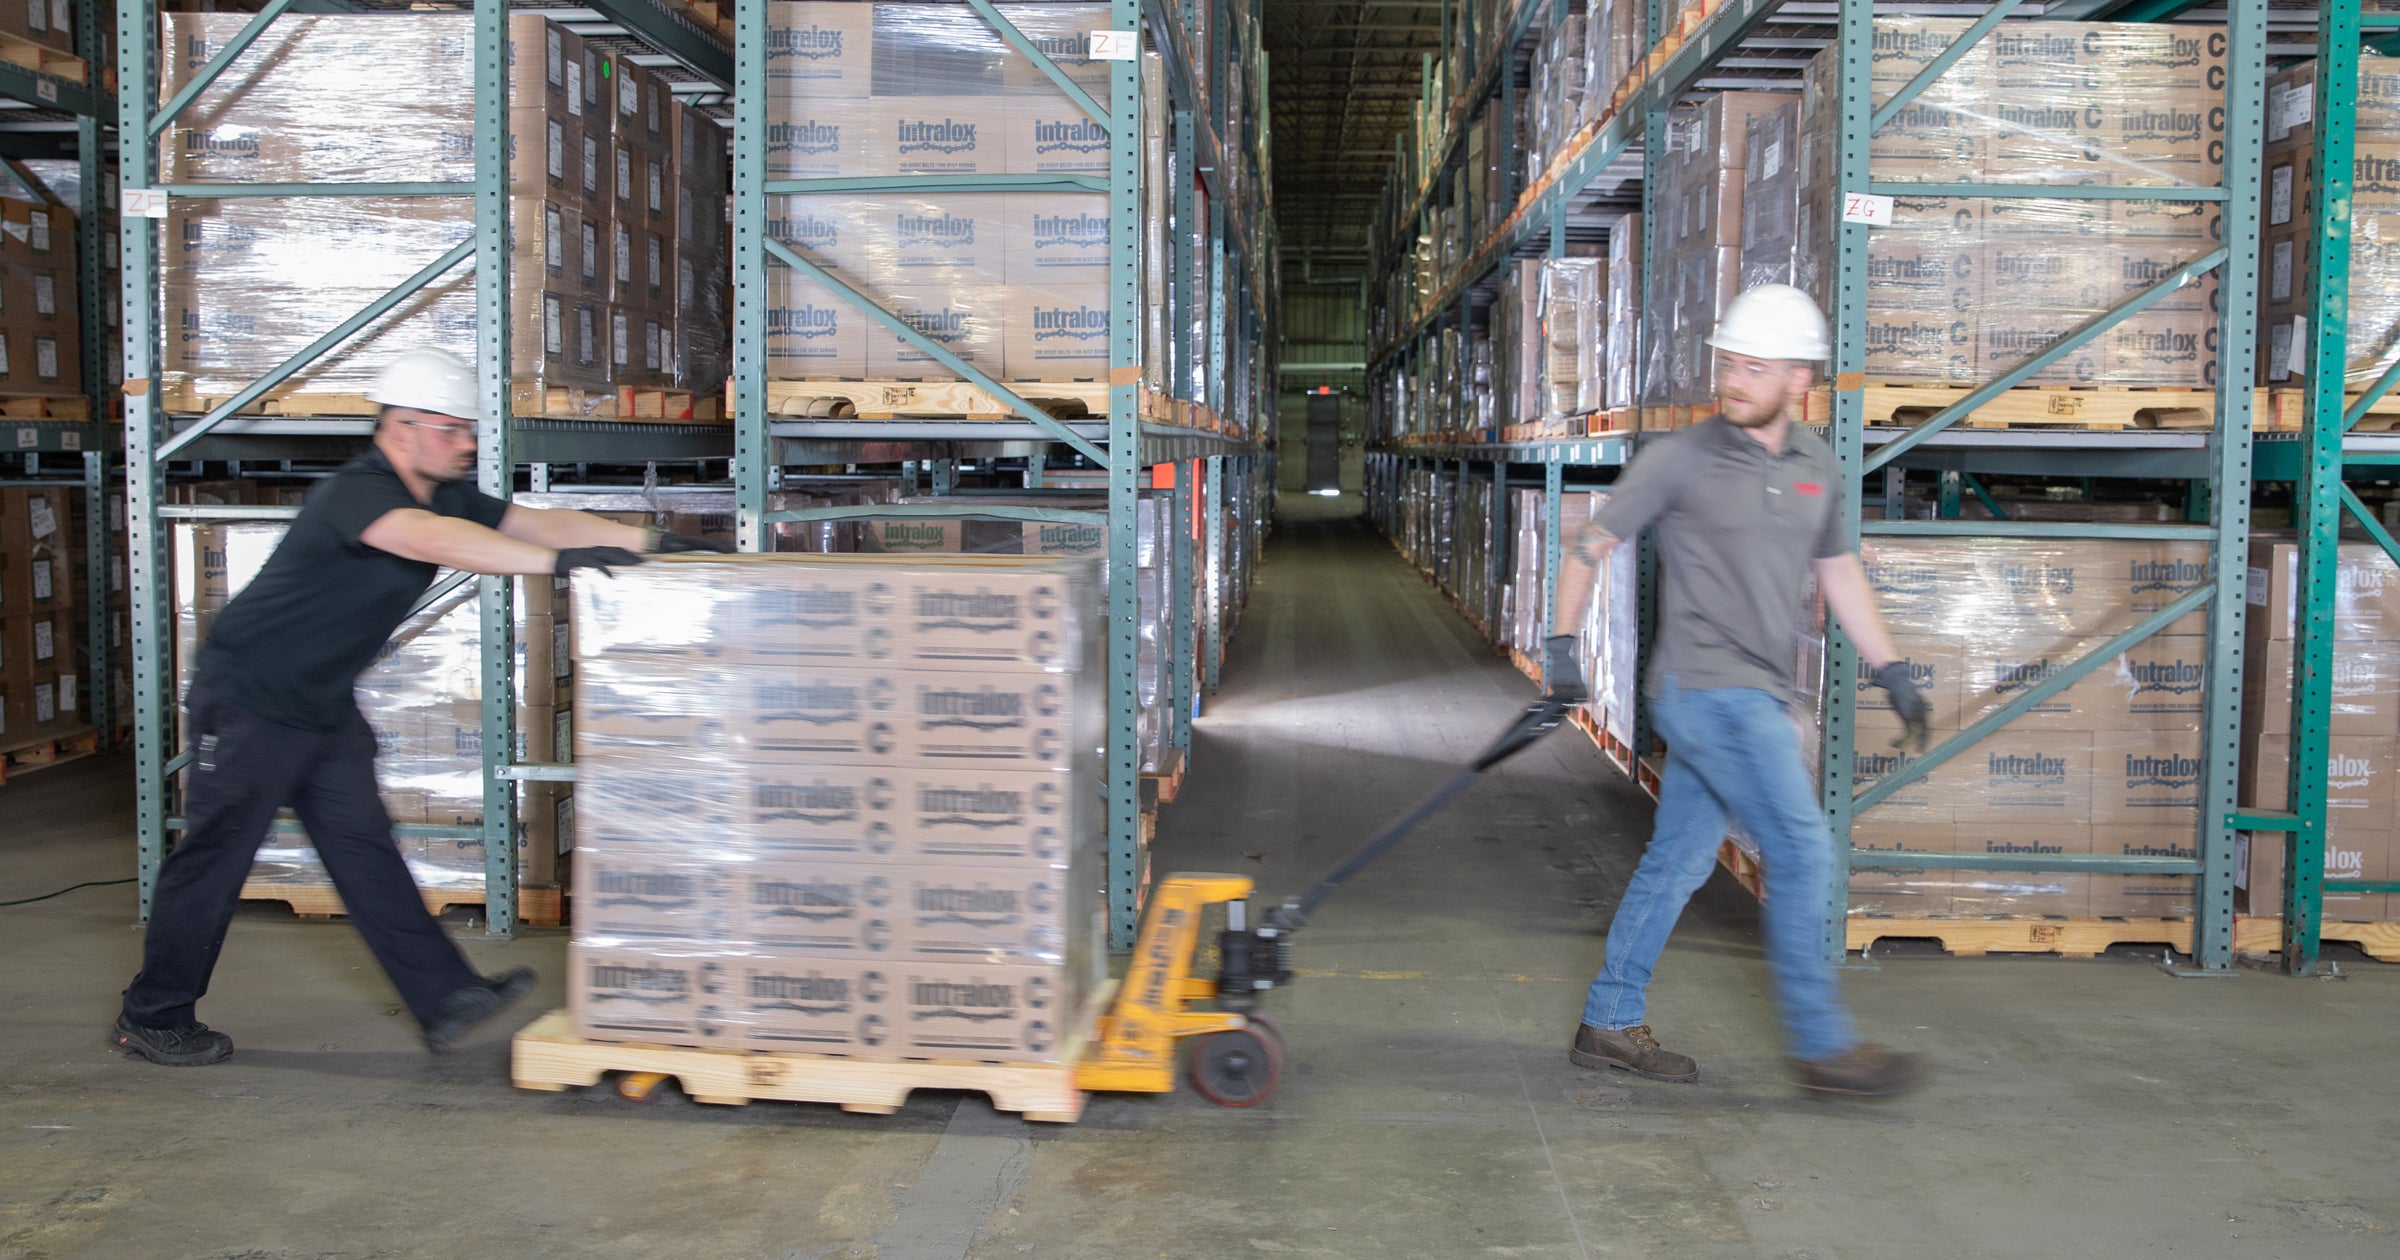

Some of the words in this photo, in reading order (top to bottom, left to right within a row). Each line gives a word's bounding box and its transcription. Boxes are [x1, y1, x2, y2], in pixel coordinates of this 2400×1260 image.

[1996, 32, 2076, 56] intralox
[2083, 31, 2101, 56] C
[2207, 33, 2226, 57] C
[2206, 65, 2225, 91] C
[1888, 104, 1949, 127] tralox
[1998, 104, 2077, 129] intralox
[2084, 103, 2102, 129] C
[2121, 108, 2202, 131] intralox
[2208, 107, 2224, 132] C
[769, 120, 840, 143] ntralox
[899, 119, 977, 142] intralox
[1035, 118, 1111, 142] intralox
[2207, 140, 2223, 165] C
[1846, 198, 1875, 217] ZG
[768, 215, 838, 238] ntralox
[898, 213, 974, 236] intralox
[1034, 213, 1111, 236] intralox
[1954, 209, 1972, 232] C
[1953, 254, 1972, 279] C
[1952, 287, 1971, 312] C
[768, 304, 837, 327] ntralox
[1034, 305, 1111, 329] intralox
[1949, 321, 1968, 345] C
[2117, 328, 2198, 351] intralox
[2075, 357, 2094, 381] C
[885, 522, 944, 540] intralox
[1040, 524, 1101, 544] intralox
[2131, 559, 2208, 582] intralox
[2334, 660, 2376, 684] alox
[1989, 752, 2066, 776] intralox
[2126, 753, 2200, 777] intralox
[2328, 754, 2370, 777] alox
[2324, 846, 2362, 869] alox
